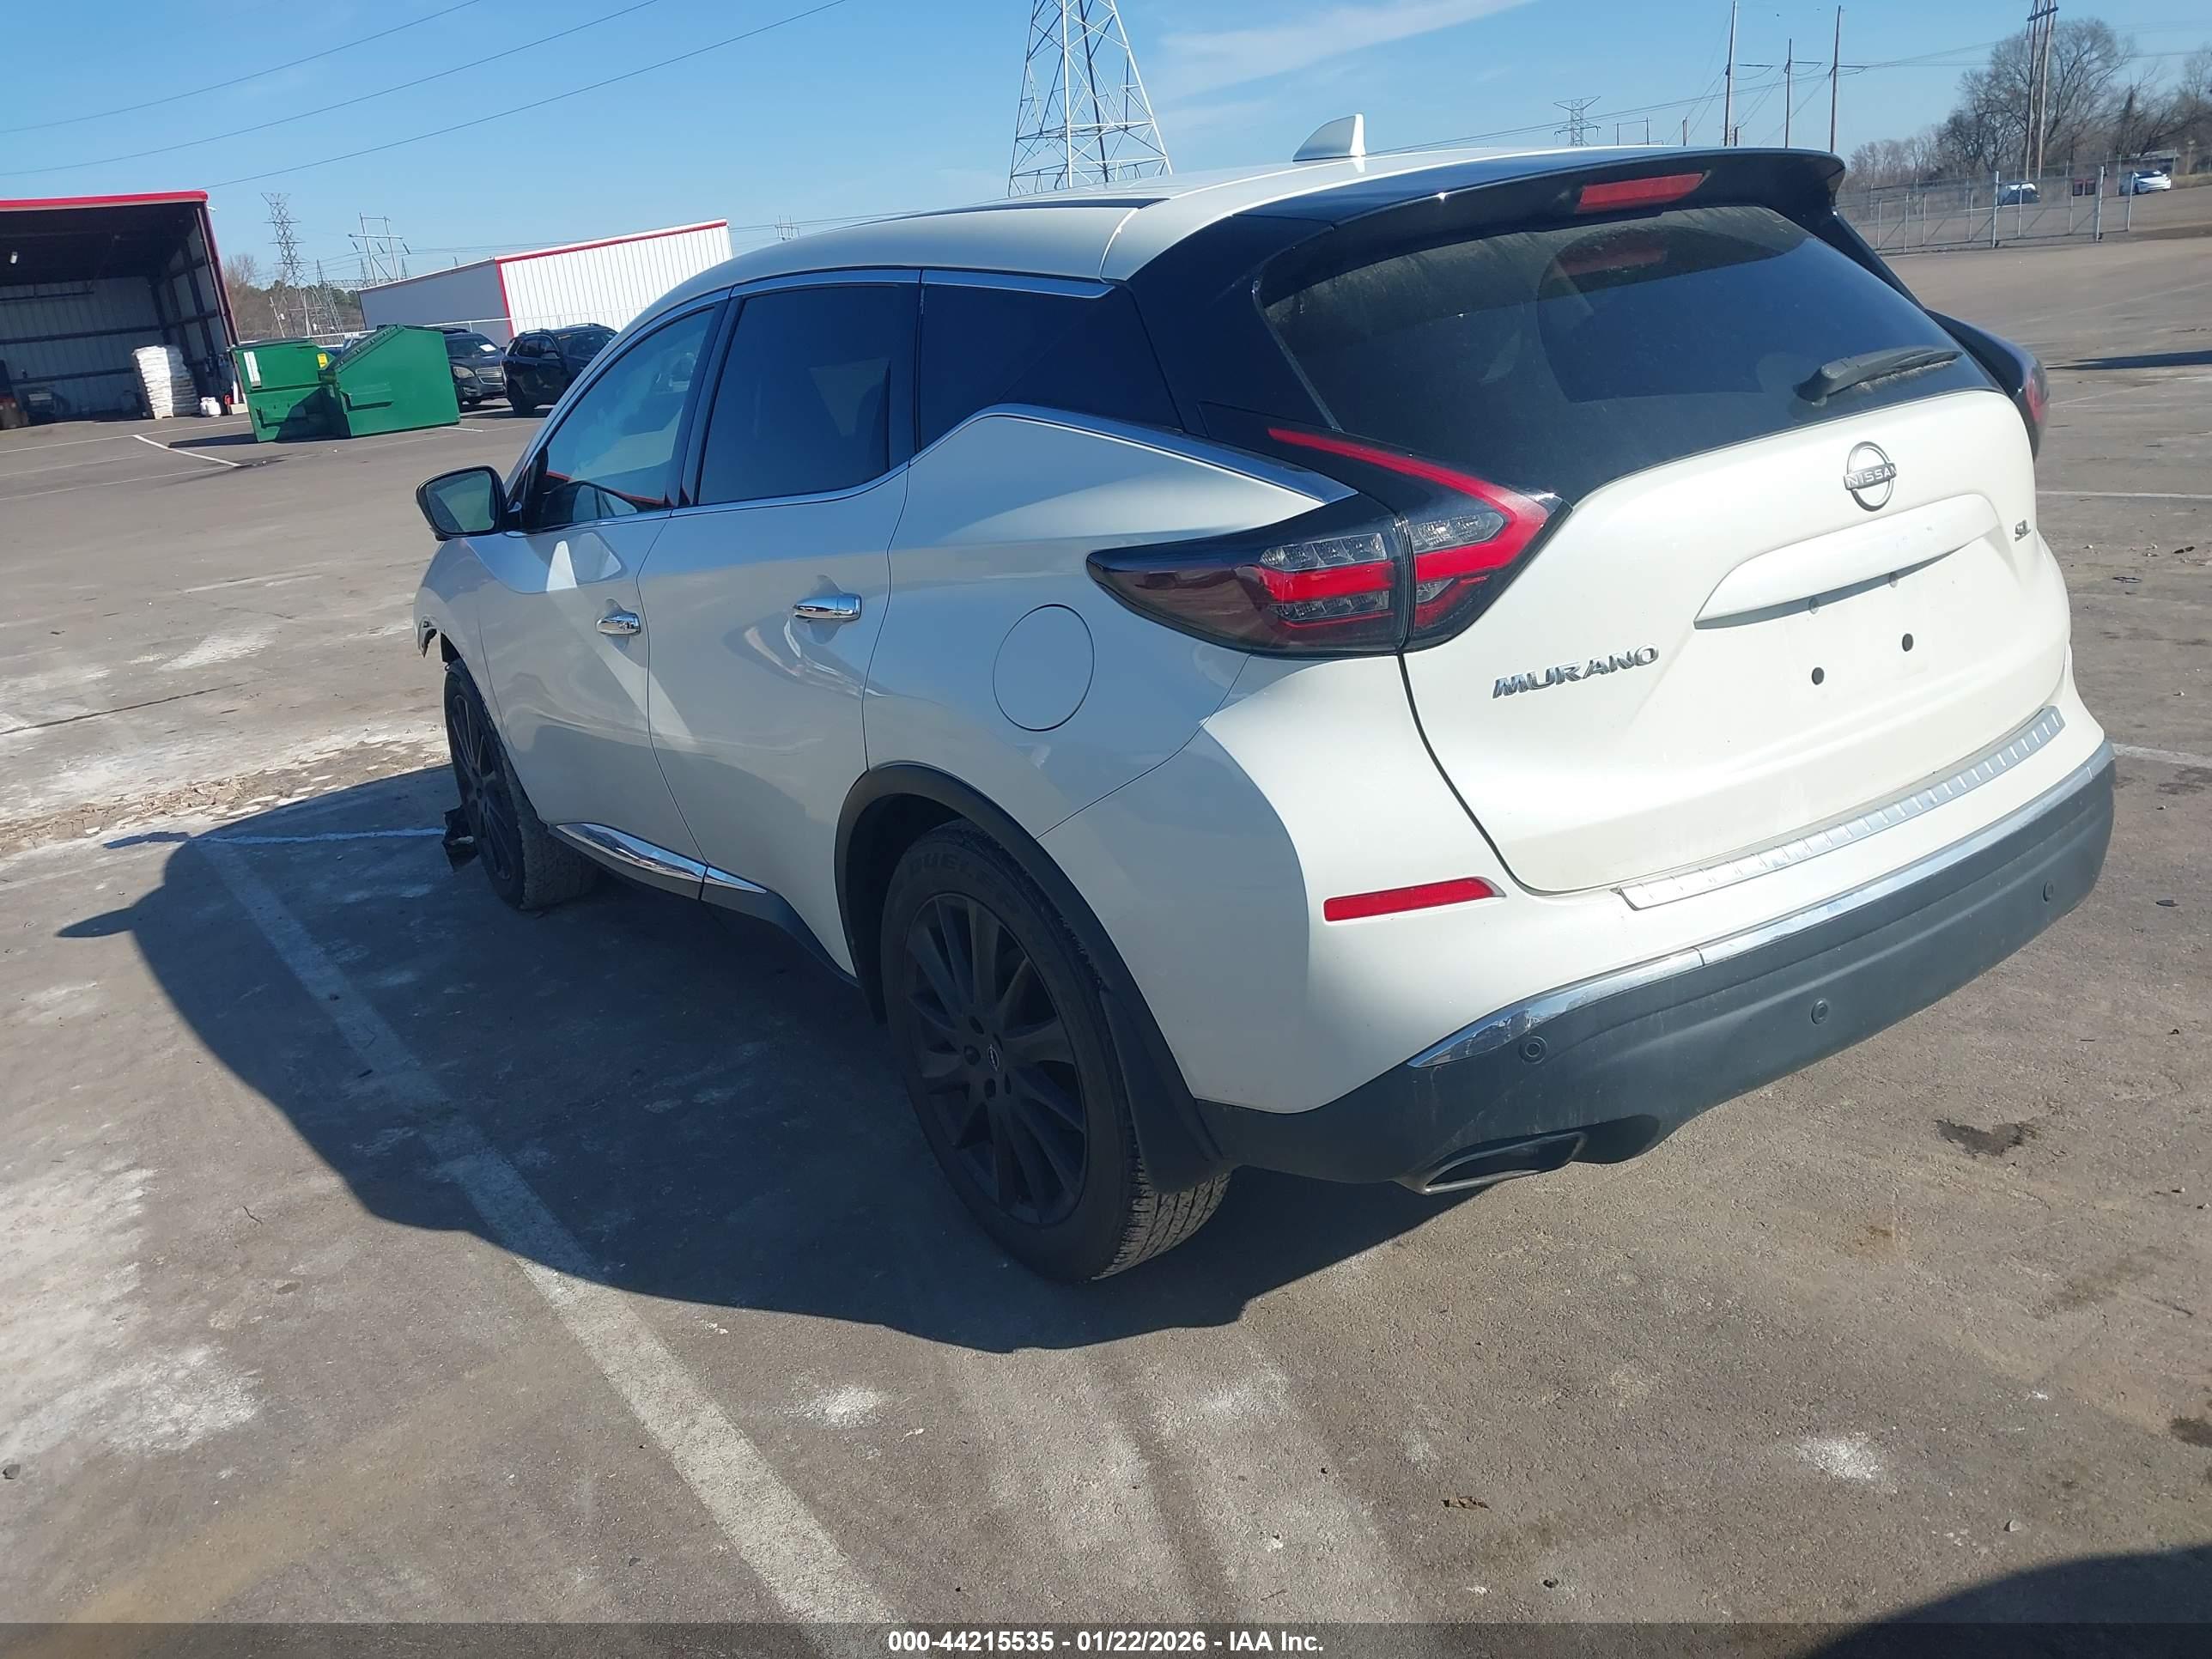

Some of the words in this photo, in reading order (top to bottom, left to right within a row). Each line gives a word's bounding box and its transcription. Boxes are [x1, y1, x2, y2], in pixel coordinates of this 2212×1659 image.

[1846, 465, 1897, 489] NISSAN
[2014, 519, 2032, 543] SL
[1492, 643, 1659, 699] MURANO
